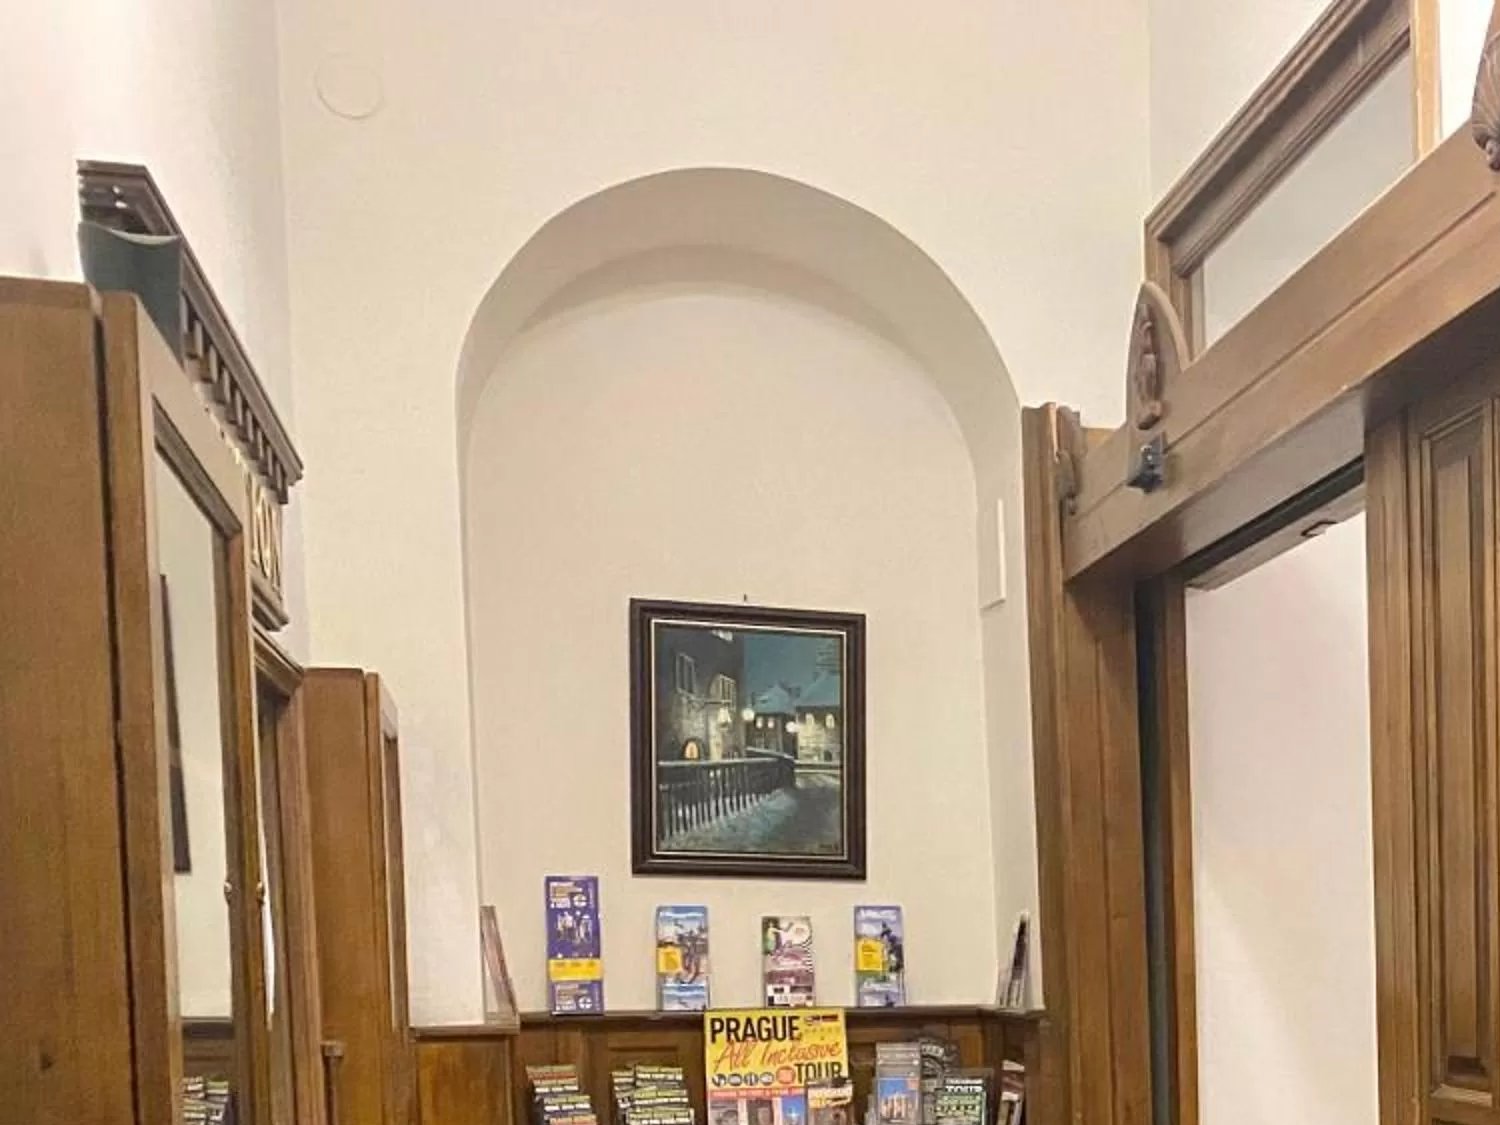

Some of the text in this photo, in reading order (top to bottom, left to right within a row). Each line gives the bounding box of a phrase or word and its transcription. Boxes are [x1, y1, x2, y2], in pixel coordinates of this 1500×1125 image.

[710, 1015, 801, 1044] PRAGUE
[713, 1039, 841, 1073] All Inclusive
[794, 1061, 843, 1084] TOUR
